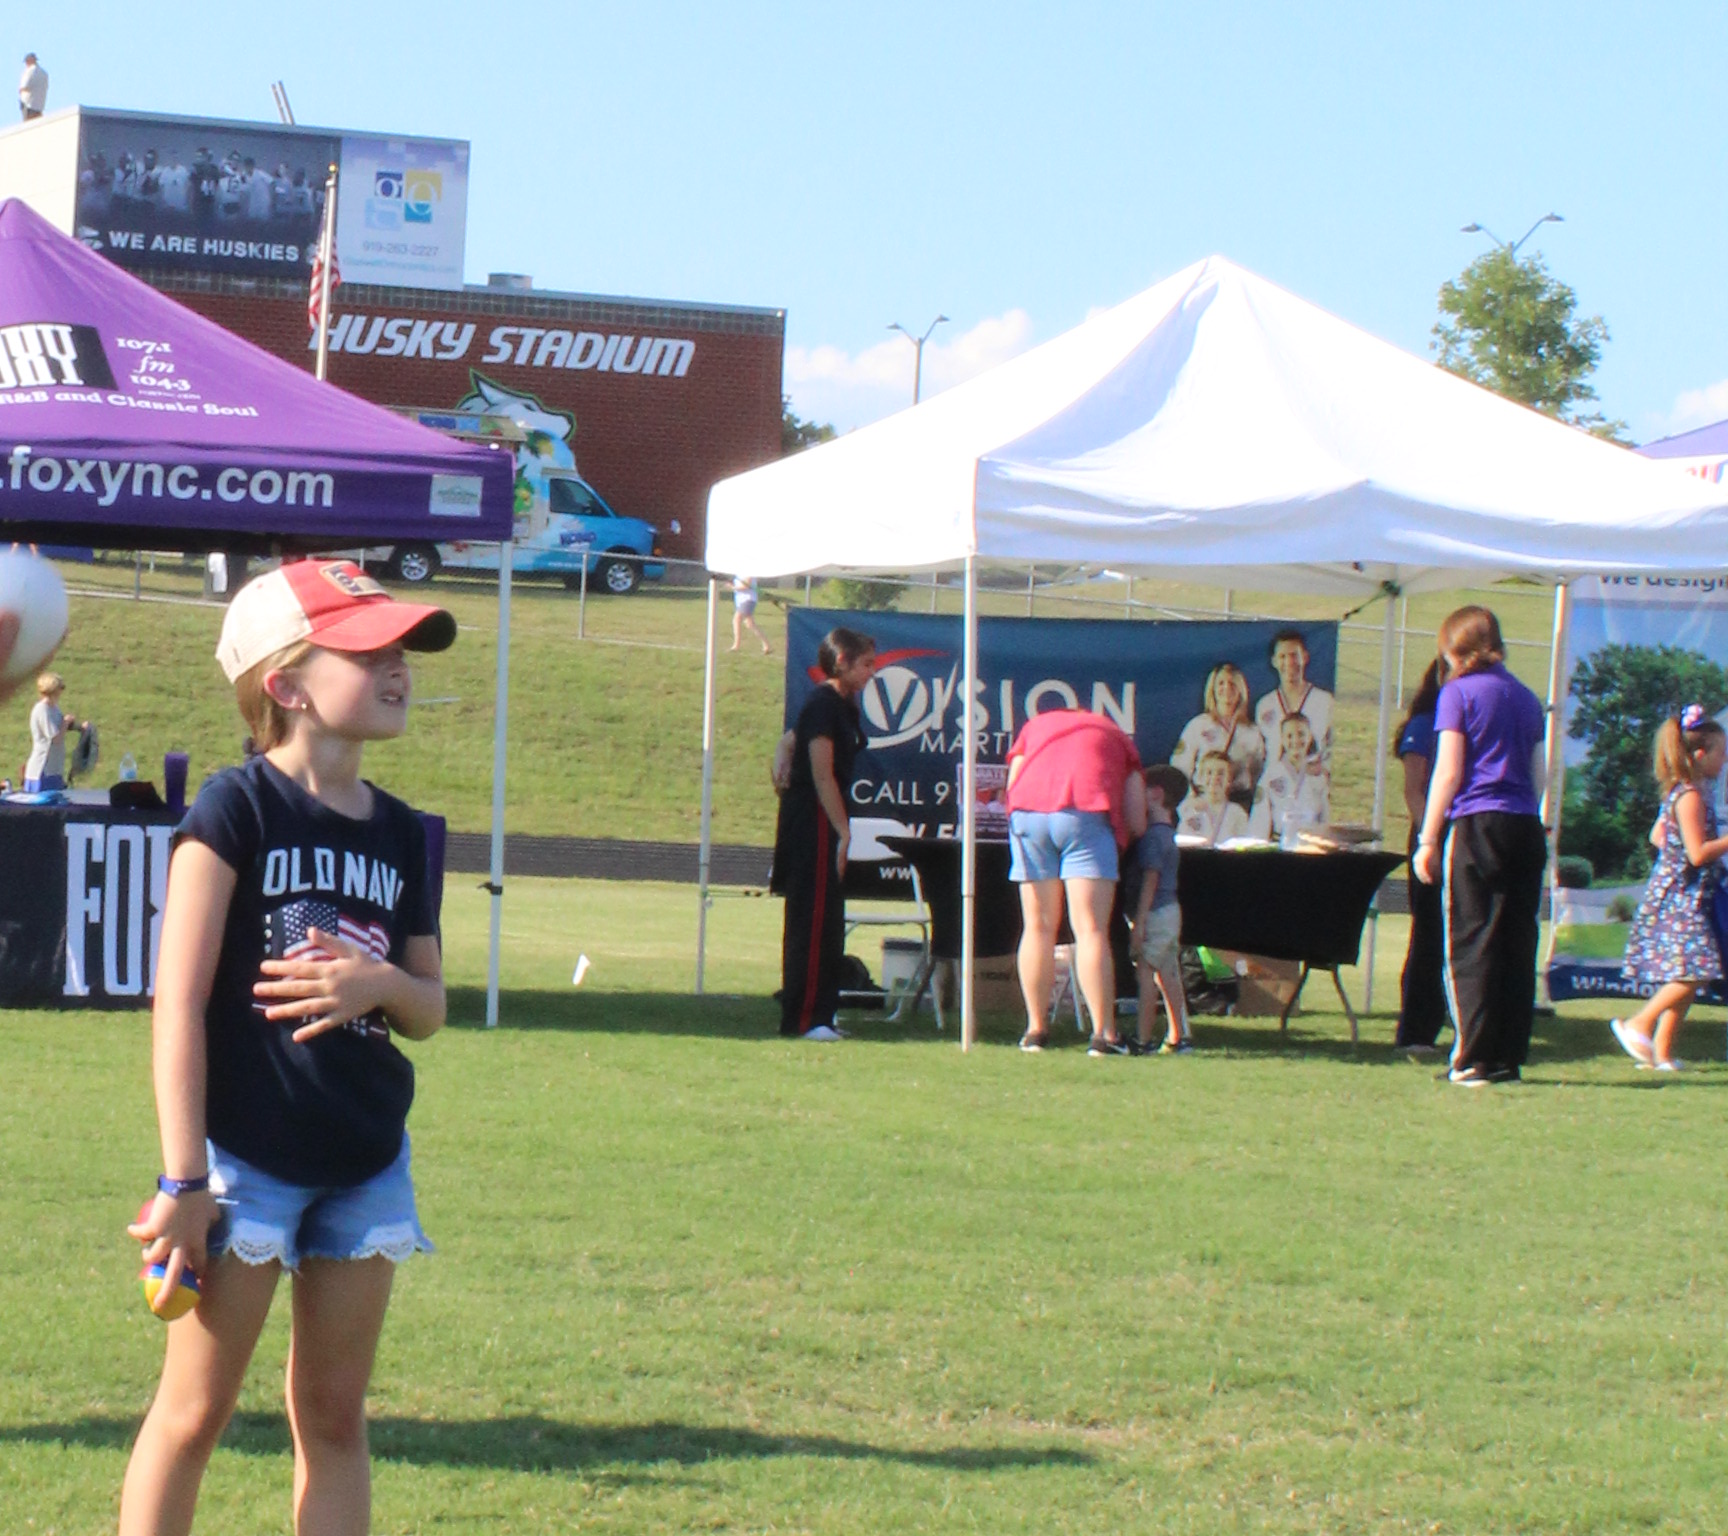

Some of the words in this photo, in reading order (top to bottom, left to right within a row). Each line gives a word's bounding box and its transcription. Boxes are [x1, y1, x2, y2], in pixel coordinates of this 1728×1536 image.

[108, 230, 145, 251] WE
[150, 235, 198, 254] ARE
[203, 238, 299, 262] HUSKIES
[116, 337, 172, 354] 107.1
[308, 312, 476, 360] HUSKY
[482, 326, 696, 378] STADIUM
[133, 355, 175, 374] fm
[55, 390, 103, 404] and
[106, 393, 199, 414] Classic
[202, 402, 260, 418] Soul
[851, 779, 925, 806] CALL
[262, 846, 336, 897] OLD
